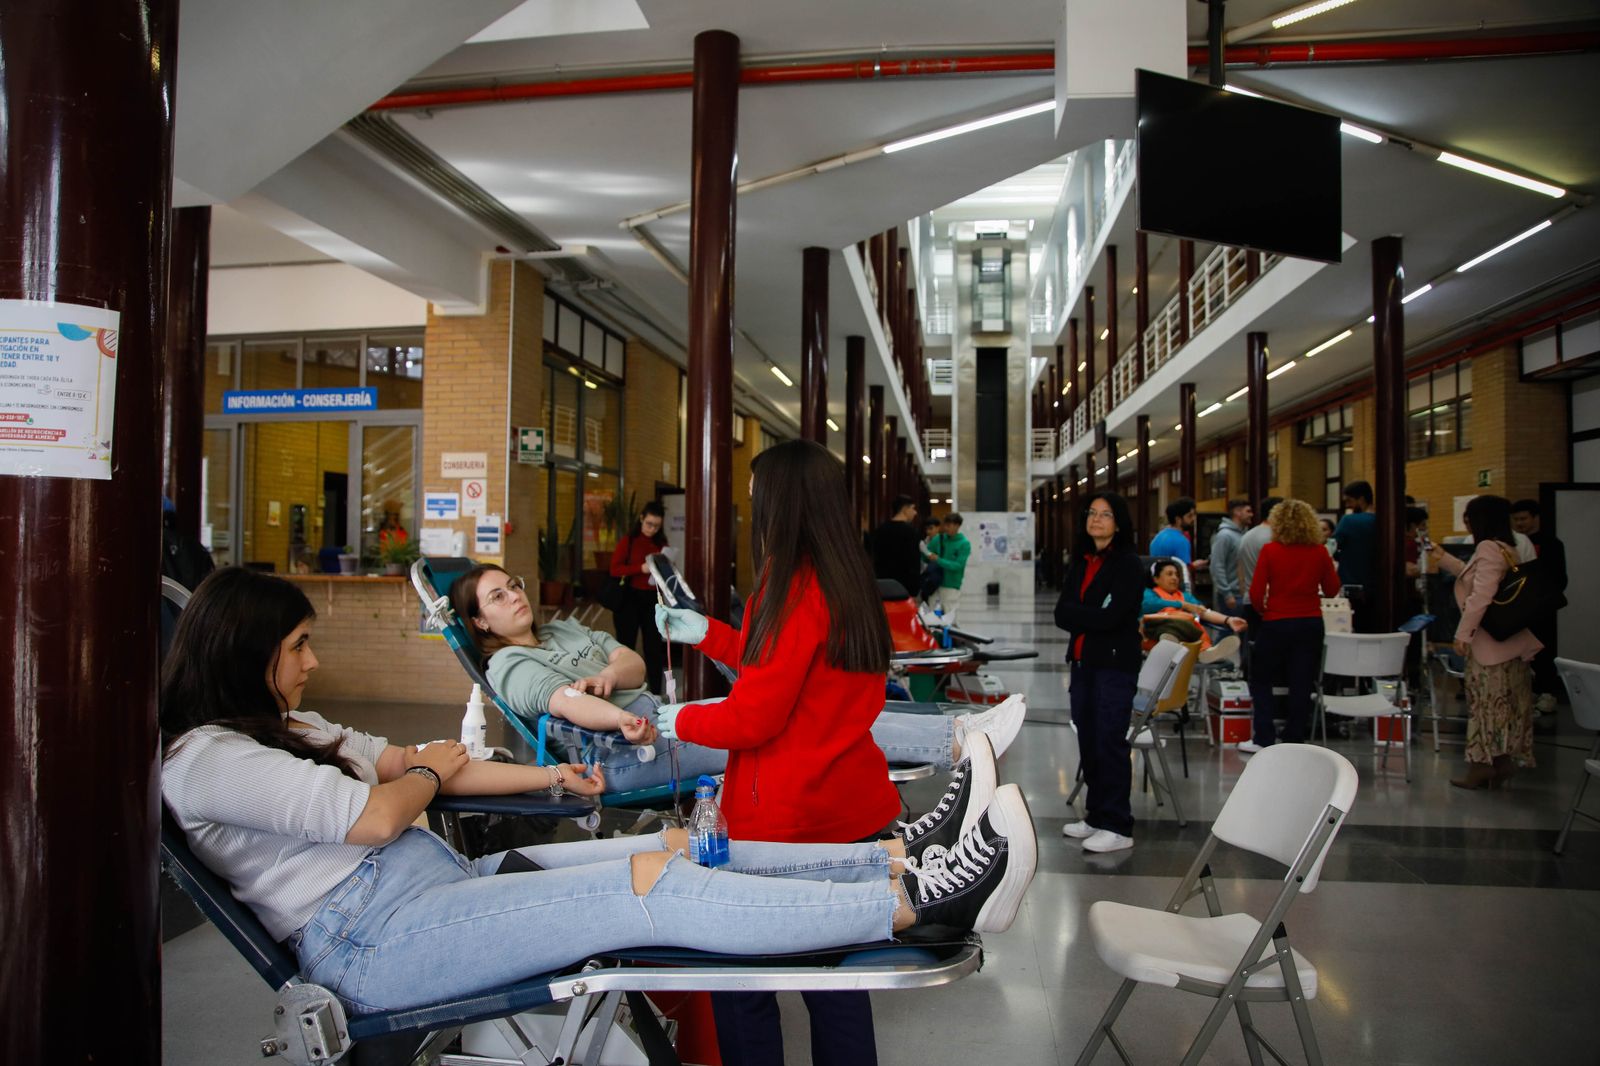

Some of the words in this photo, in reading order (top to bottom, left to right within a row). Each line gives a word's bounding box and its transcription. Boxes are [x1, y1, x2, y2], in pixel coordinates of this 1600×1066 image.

[30, 337, 50, 345] PARA
[22, 354, 44, 362] ENTRE
[228, 392, 295, 408] INFORMACIÓN
[303, 390, 372, 407] CONSERJERÍA
